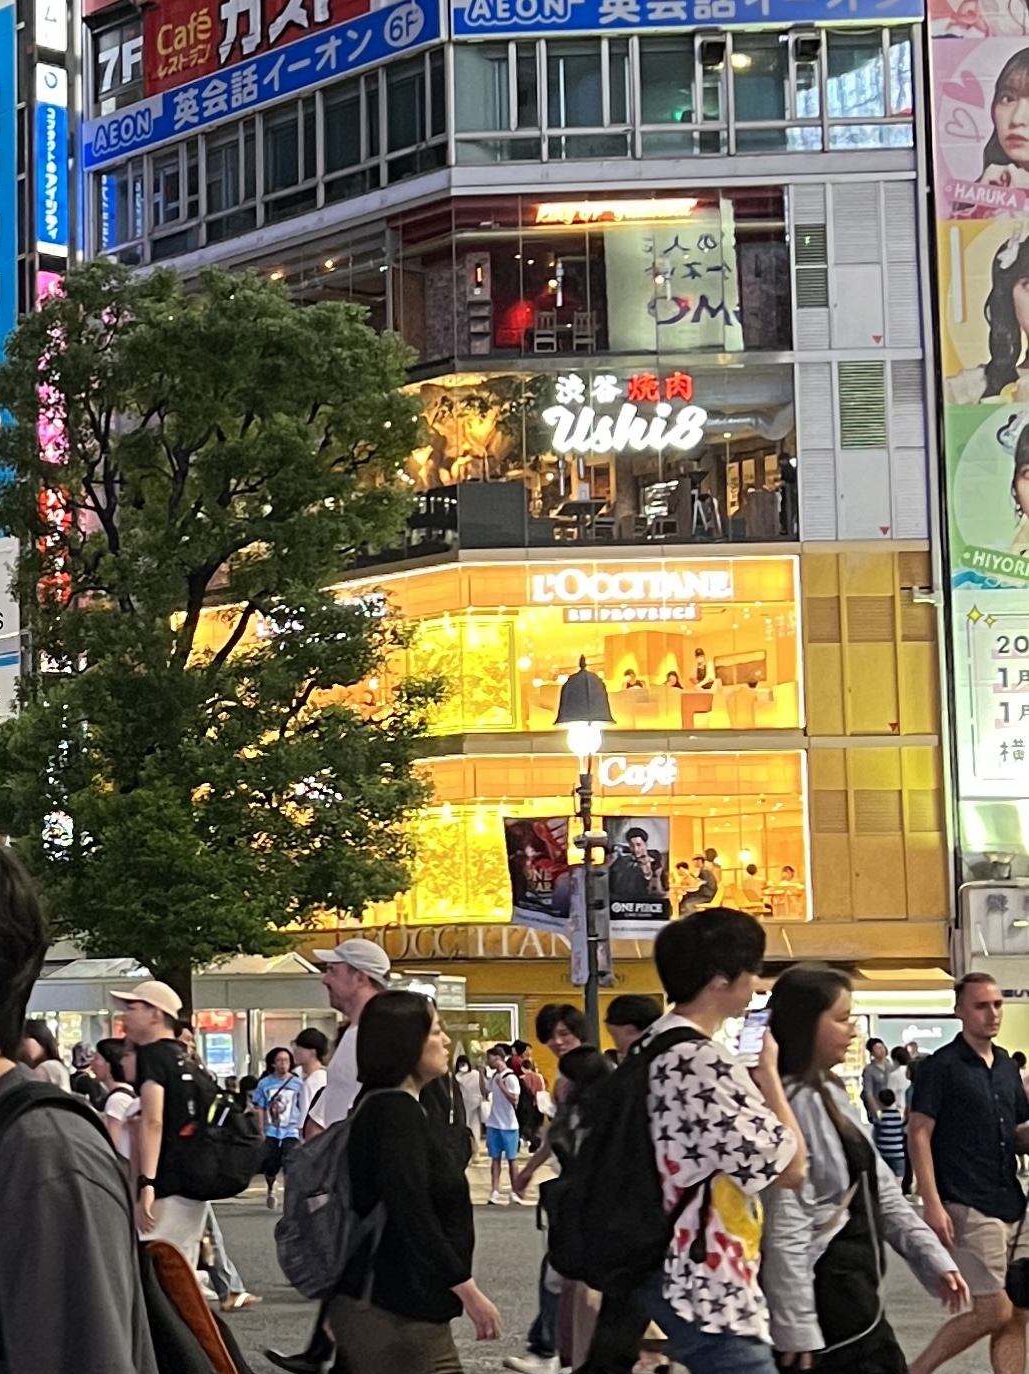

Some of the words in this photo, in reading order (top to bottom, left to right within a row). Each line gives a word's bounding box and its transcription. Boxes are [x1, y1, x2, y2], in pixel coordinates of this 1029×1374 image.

[157, 8, 212, 57] Café
[99, 36, 143, 93] 7F
[158, 44, 212, 80] レストラン
[93, 108, 151, 152] AEON
[388, 14, 420, 42] 6F
[954, 183, 1018, 208] HARUKA
[533, 568, 731, 602] L'OCCITANE
[598, 756, 679, 794] Café
